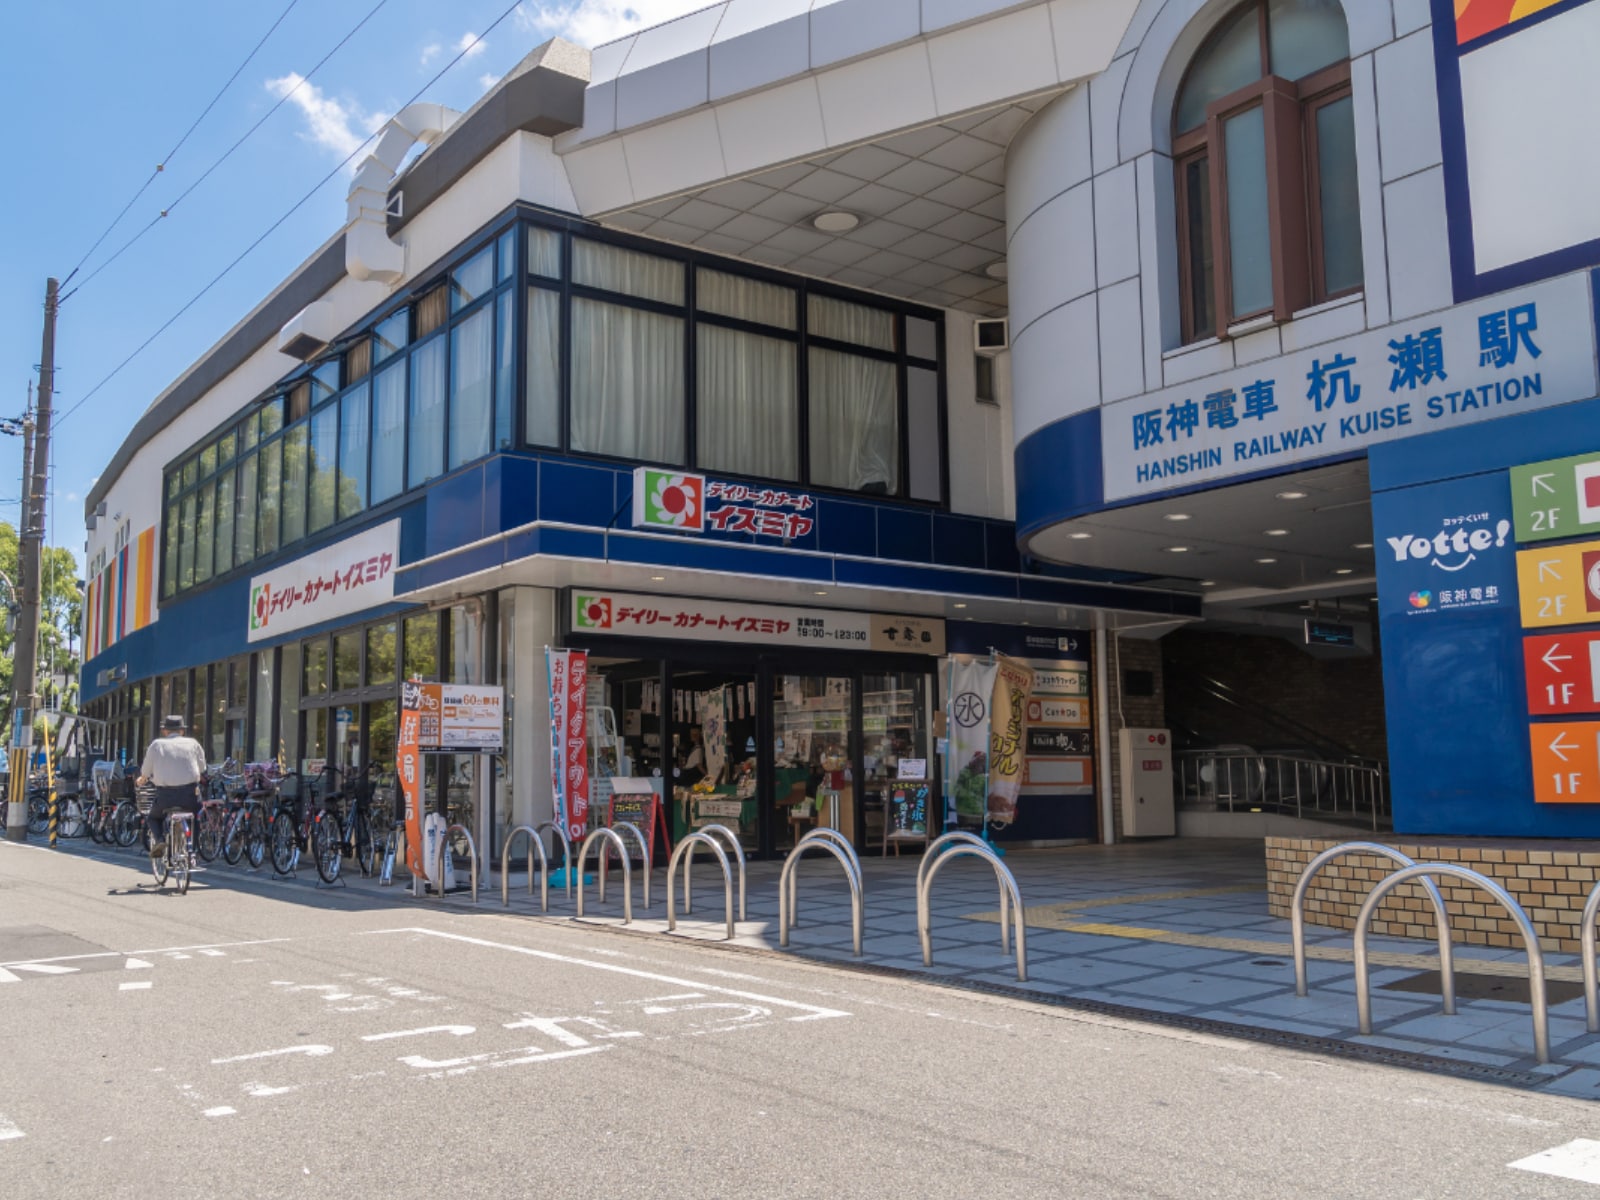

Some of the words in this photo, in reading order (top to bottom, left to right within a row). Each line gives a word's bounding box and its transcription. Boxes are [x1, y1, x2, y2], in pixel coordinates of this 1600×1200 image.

[1132, 379, 1279, 451] 阪神電車
[1136, 446, 1223, 484] HANSHIN
[1233, 422, 1328, 463] RAILWAY
[1339, 403, 1413, 439] KUISE
[1427, 372, 1543, 419] STATION
[706, 504, 815, 540] イズミヤ
[1530, 507, 1561, 533] 2F
[1386, 518, 1511, 562] Yotte!
[1439, 585, 1499, 604] 阪神電車
[1536, 594, 1569, 618] 2F
[1545, 682, 1576, 706] 1F
[957, 694, 983, 723] 氷
[1552, 772, 1583, 795] 1F
